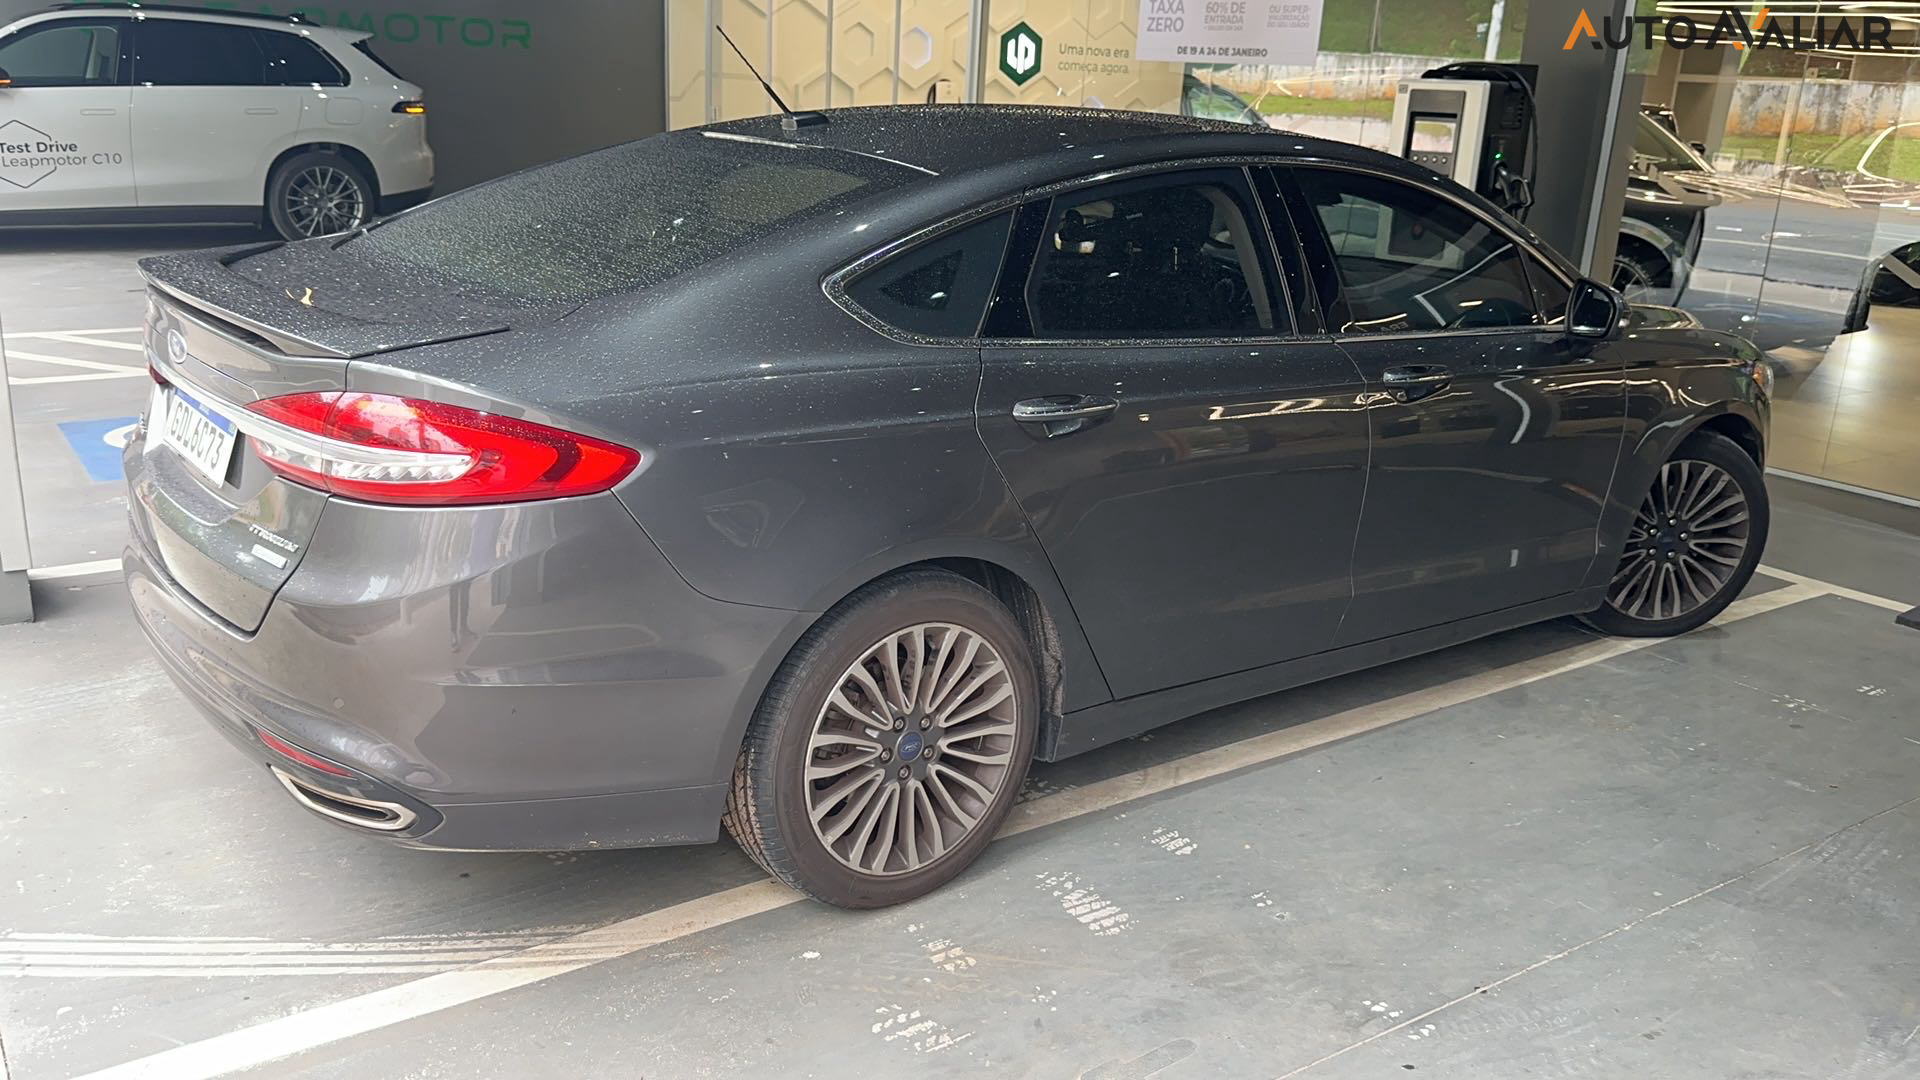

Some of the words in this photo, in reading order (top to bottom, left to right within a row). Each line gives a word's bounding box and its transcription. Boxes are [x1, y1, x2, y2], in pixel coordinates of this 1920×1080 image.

[1150, 0, 1185, 14] TAXA
[1206, 1, 1229, 14] 60%
[1231, 1, 1246, 14] DE
[1147, 17, 1185, 32] ZERO
[1204, 14, 1244, 25] ENTRADA
[1059, 43, 1084, 55] Uma
[1086, 48, 1111, 57] nova
[1113, 49, 1129, 58] era
[1177, 46, 1188, 55] DE
[1190, 46, 1197, 55] 19
[1199, 46, 1205, 55] A
[1206, 47, 1217, 56] 24
[1218, 47, 1229, 56] DE
[1231, 47, 1268, 57] JANEIRO
[1057, 62, 1098, 74] começa
[0, 142, 31, 153] Test
[36, 140, 78, 153] Drive
[1, 154, 87, 168] Leapmotor
[92, 153, 122, 165] C10
